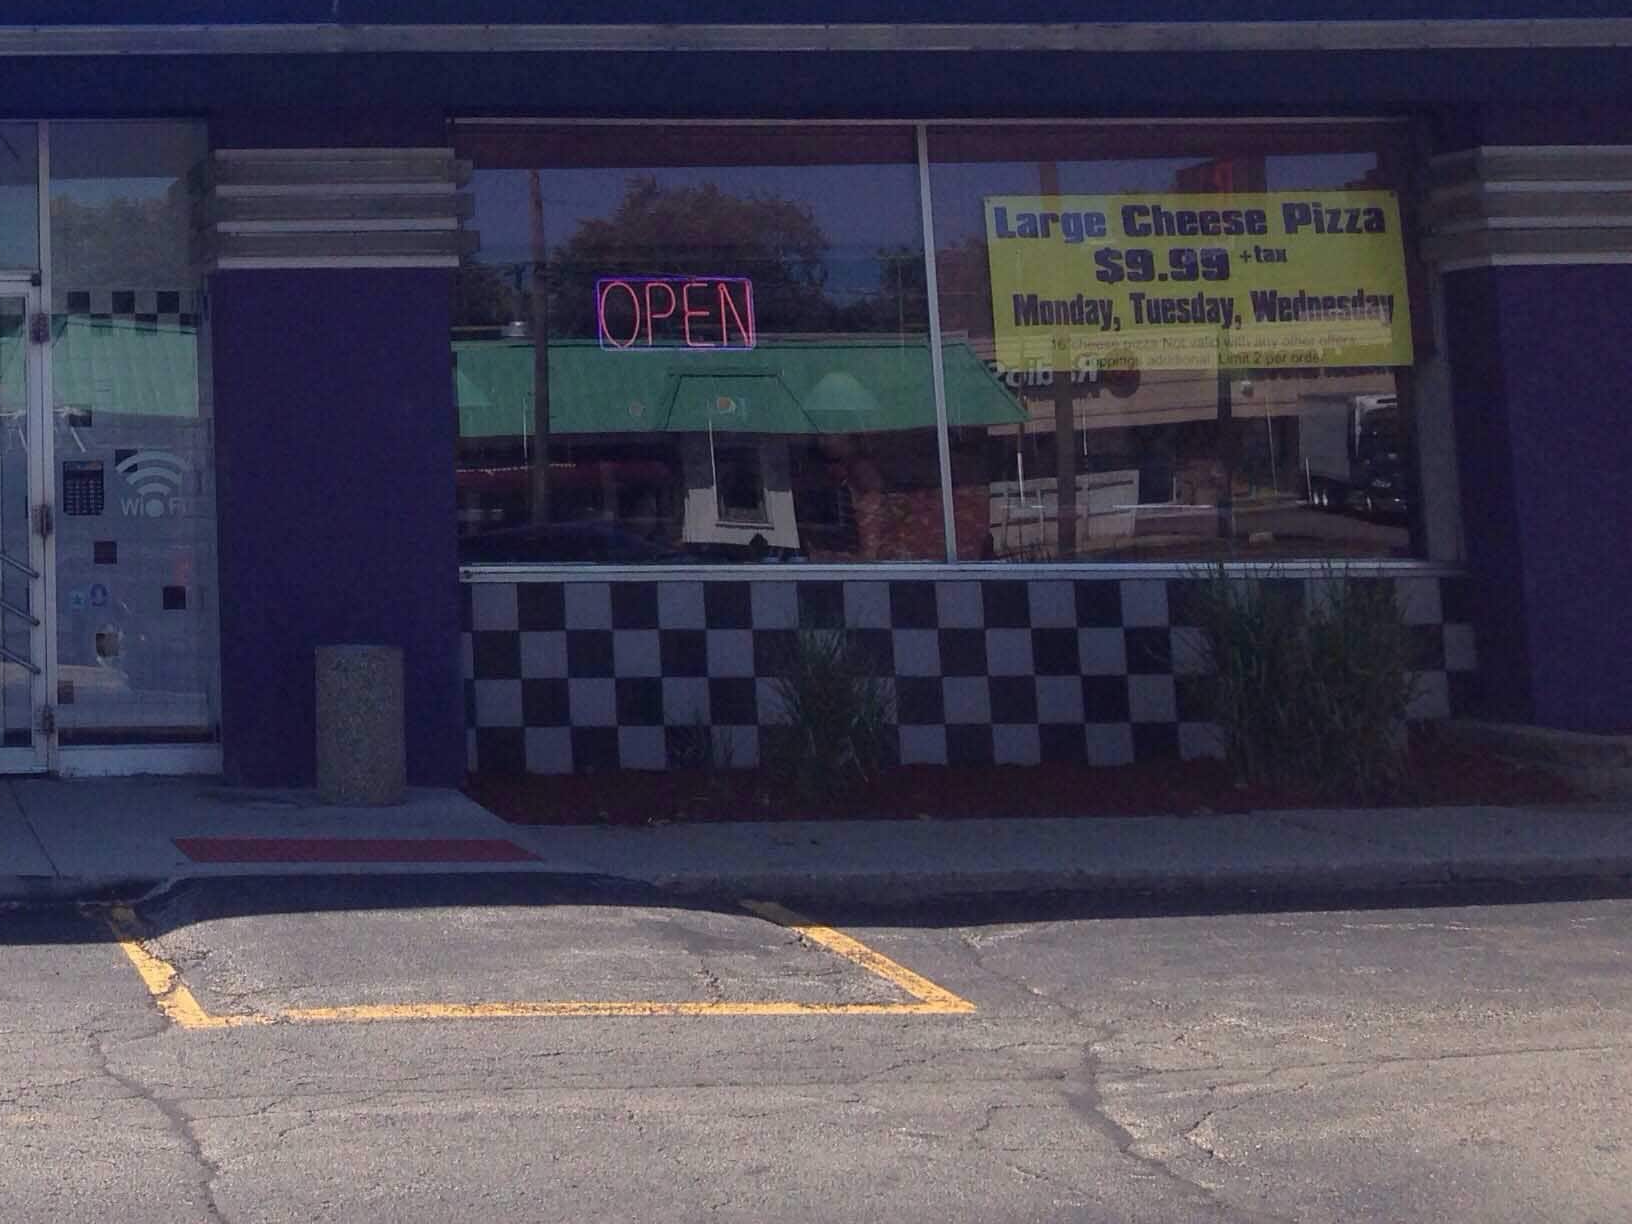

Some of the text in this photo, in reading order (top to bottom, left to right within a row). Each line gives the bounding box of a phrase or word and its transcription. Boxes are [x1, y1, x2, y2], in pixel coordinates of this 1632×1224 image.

[993, 201, 1386, 243] Large Cheese Pizza
[1094, 247, 1231, 285] $9.99
[600, 282, 753, 349] OPEN
[1012, 289, 1395, 331] Monday, Tuesday, Wednesday
[1253, 350, 1263, 364] 2
